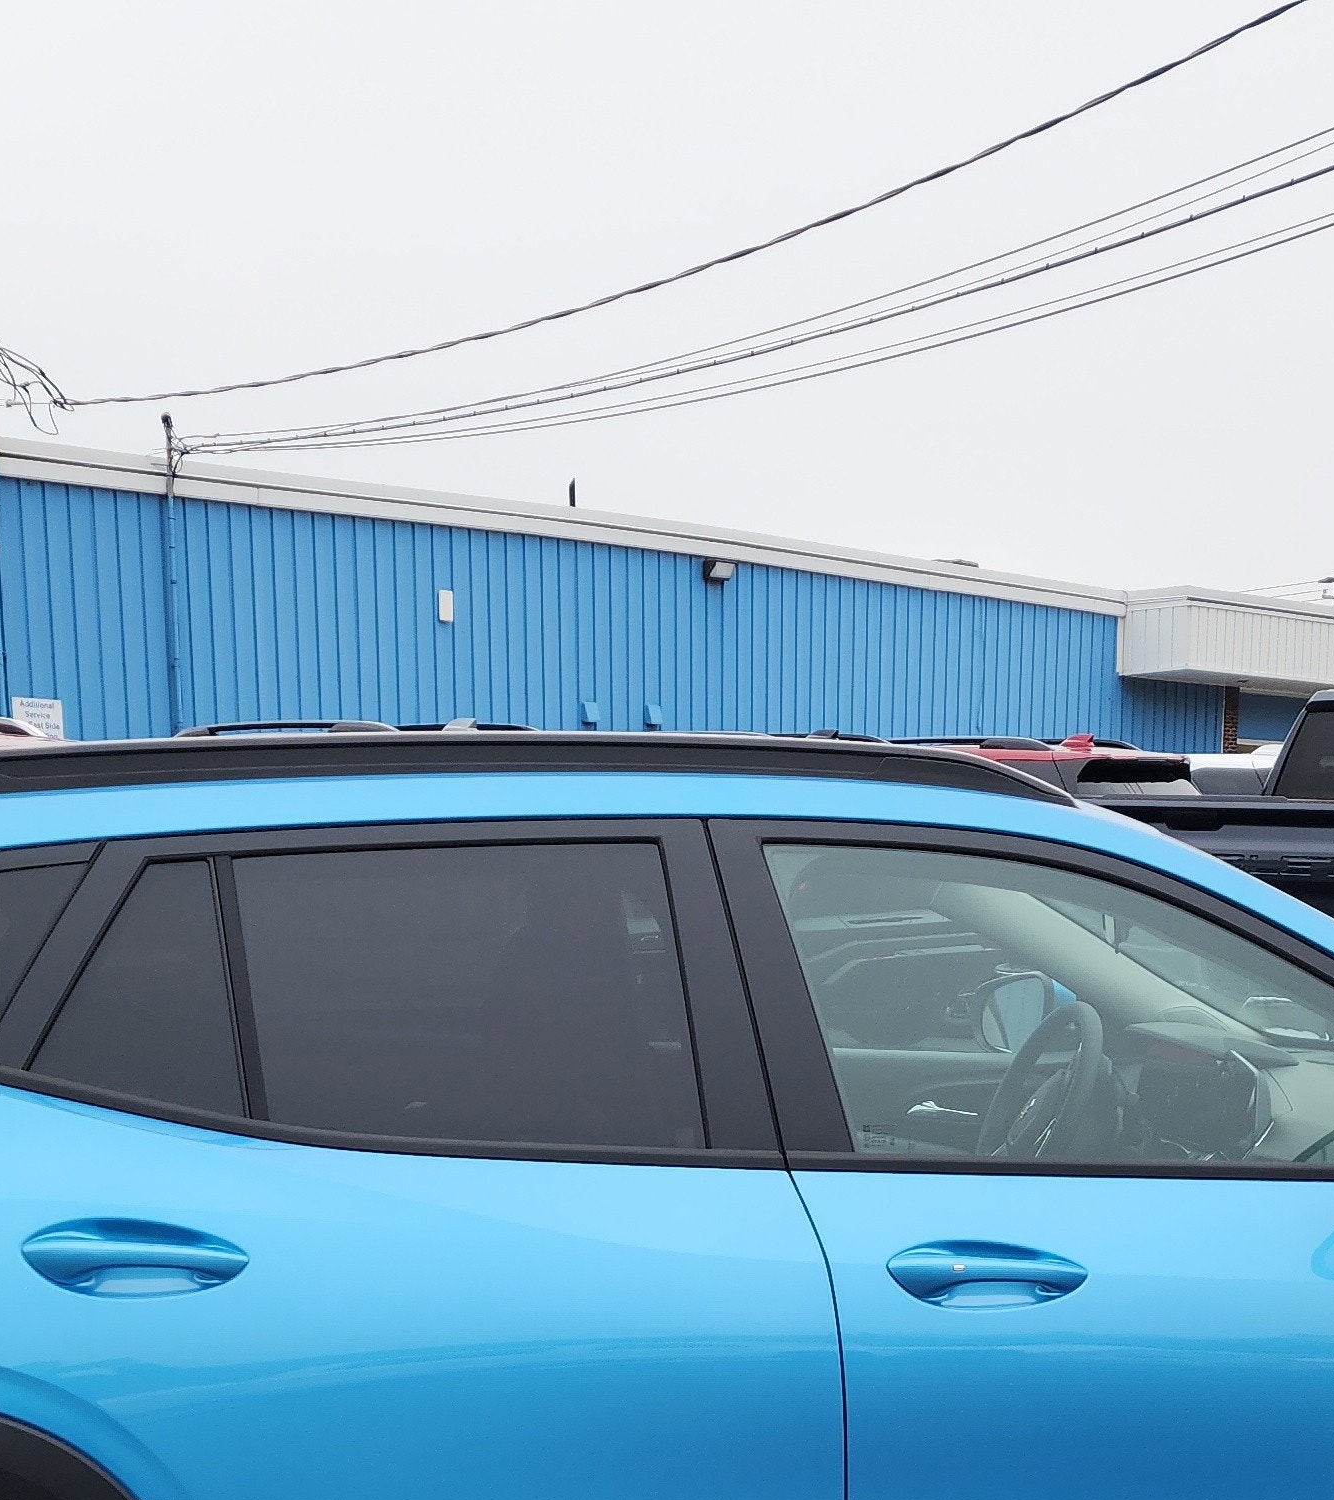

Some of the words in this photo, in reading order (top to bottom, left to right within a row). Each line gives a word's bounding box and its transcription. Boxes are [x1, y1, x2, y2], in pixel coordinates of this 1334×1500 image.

[20, 700, 54, 709] Additional
[25, 711, 50, 719] Service
[45, 722, 60, 730] Side
